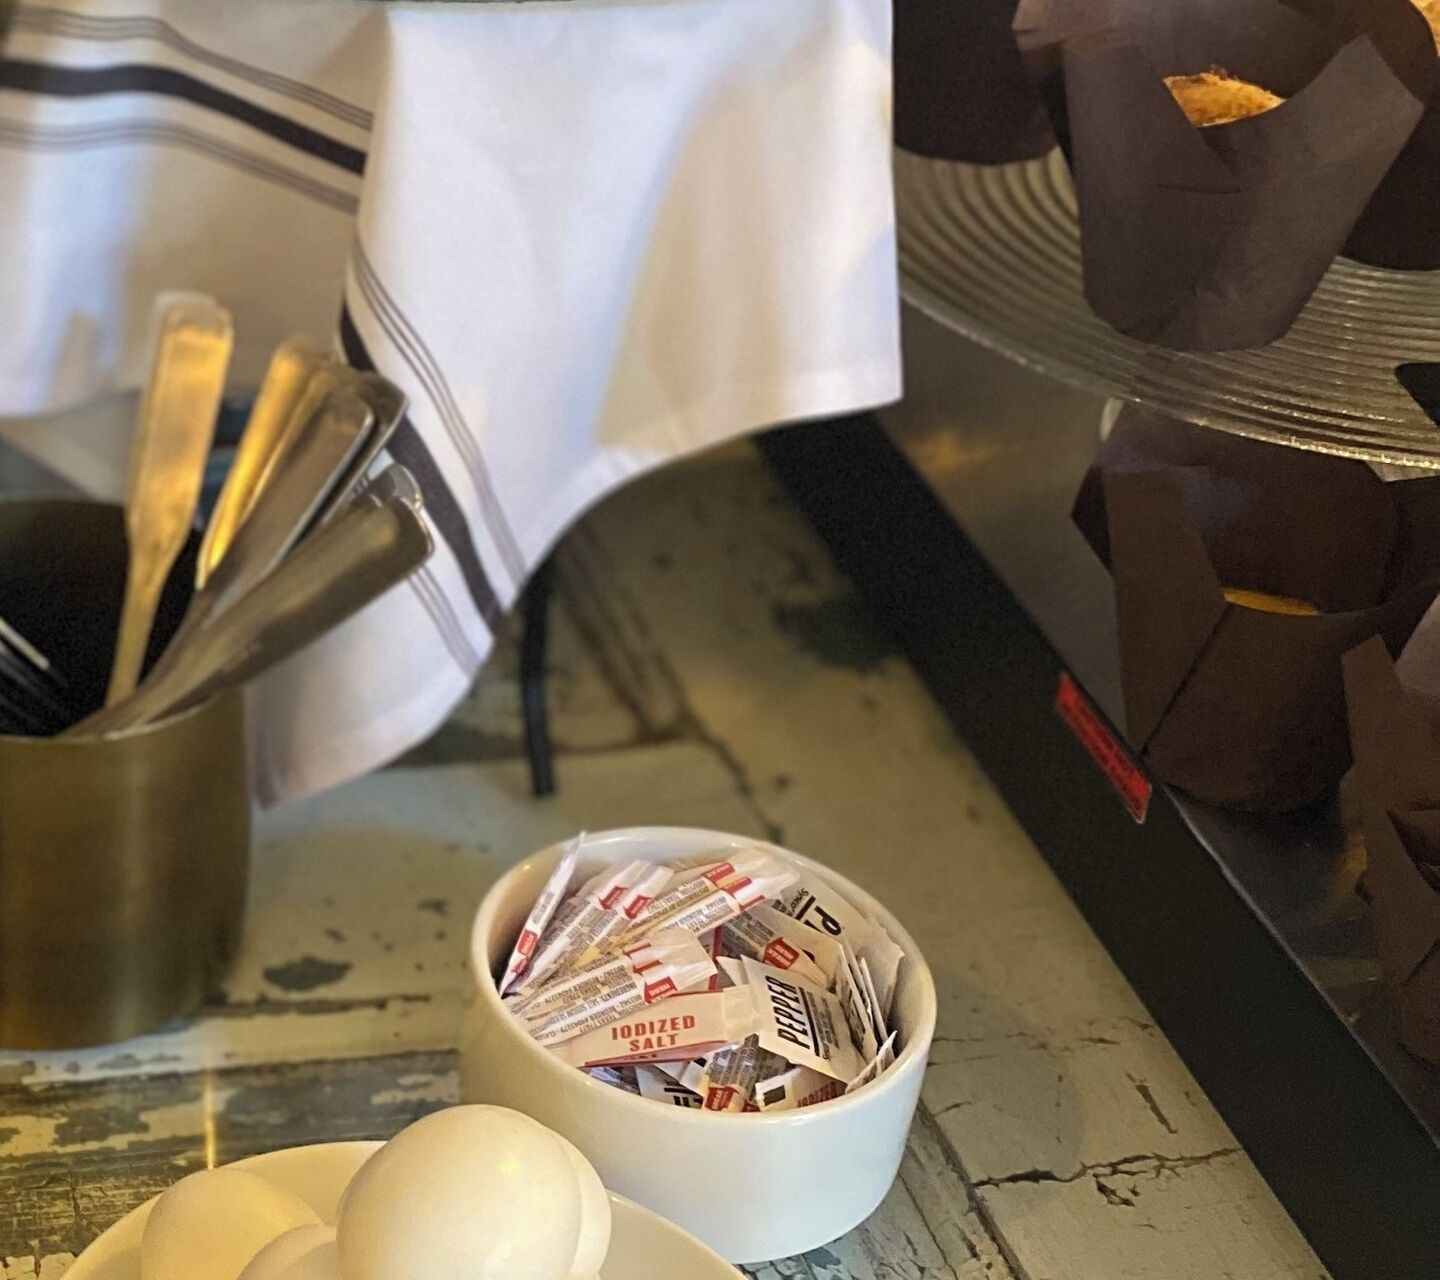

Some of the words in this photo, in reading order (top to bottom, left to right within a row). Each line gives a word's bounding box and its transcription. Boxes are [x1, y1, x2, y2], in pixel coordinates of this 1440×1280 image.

[765, 975, 811, 1050] PEPPER
[611, 1014, 696, 1041] IODIZED
[628, 1032, 679, 1053] SALT
